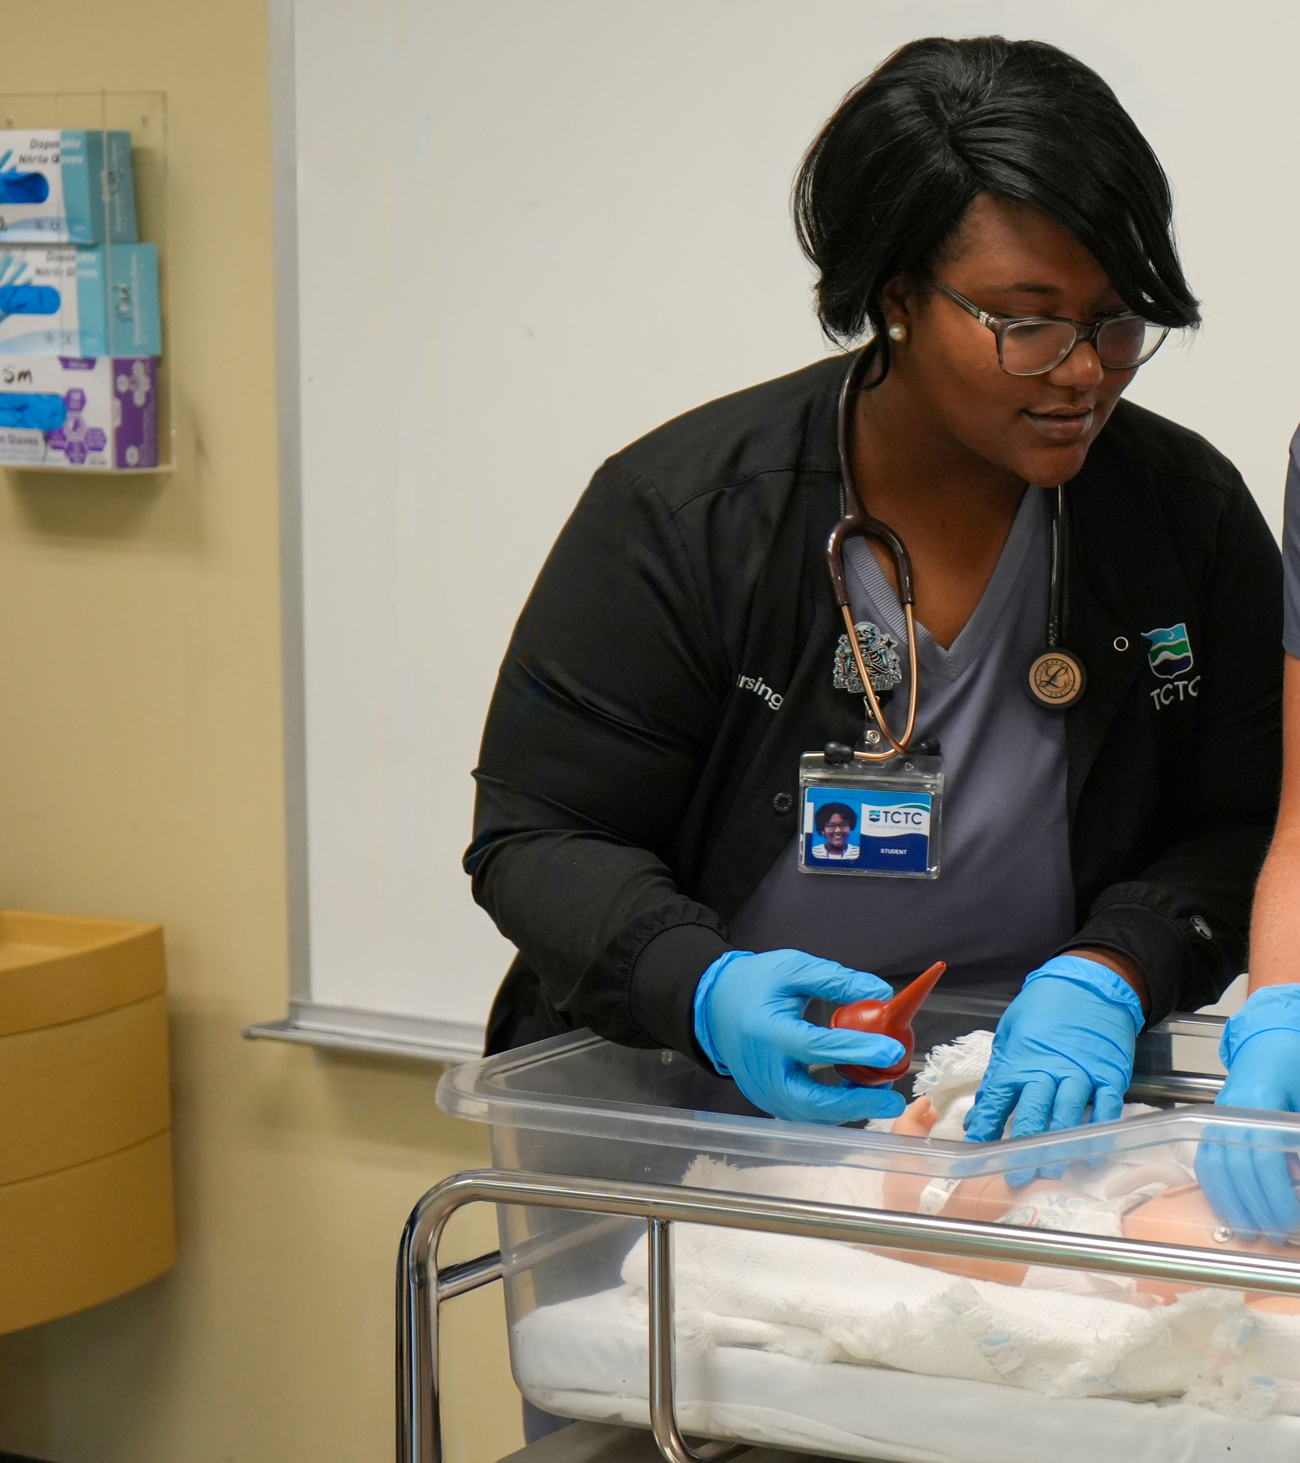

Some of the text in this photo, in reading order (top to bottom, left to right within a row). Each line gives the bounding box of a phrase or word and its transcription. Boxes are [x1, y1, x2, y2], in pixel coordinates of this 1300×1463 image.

[19, 153, 48, 163] Nitrile
[737, 674, 784, 710] rsing
[1150, 675, 1201, 710] TCTC
[883, 811, 923, 825] TCTC
